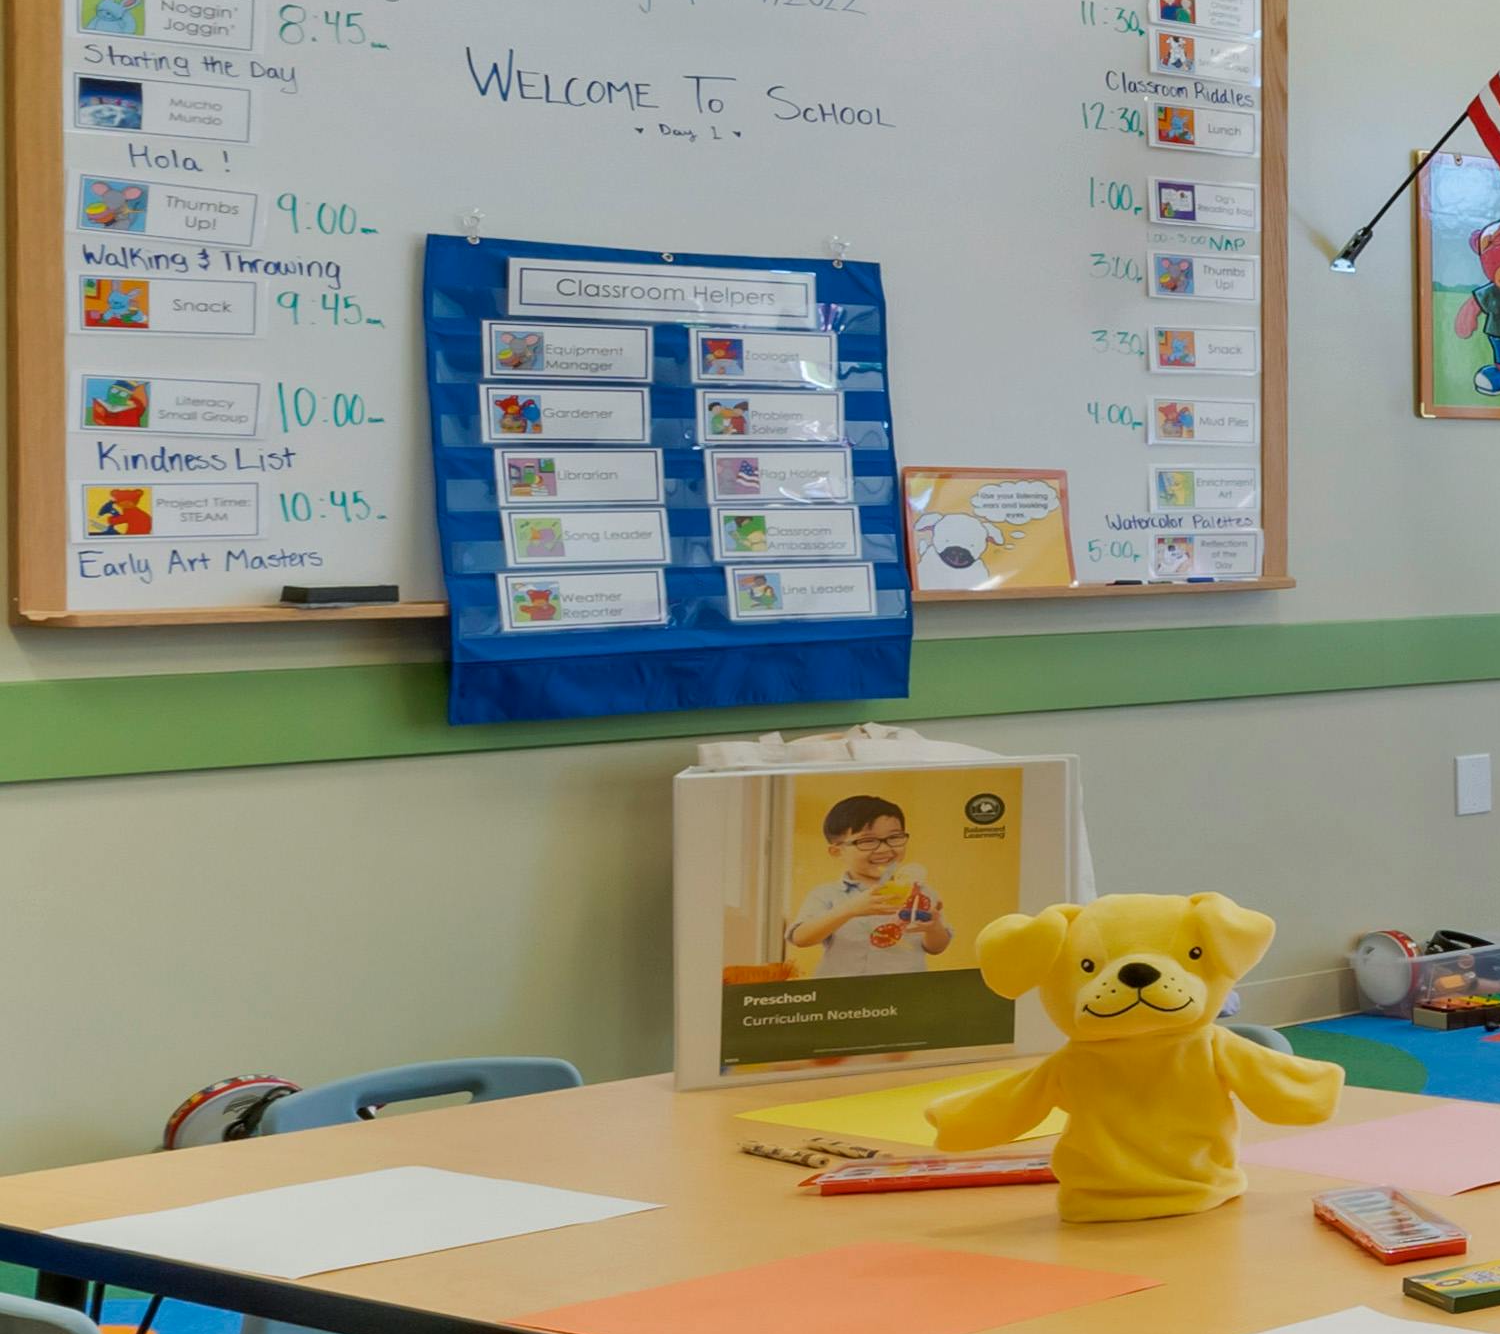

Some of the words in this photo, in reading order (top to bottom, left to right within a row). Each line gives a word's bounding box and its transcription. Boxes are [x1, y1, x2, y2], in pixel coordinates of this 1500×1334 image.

[85, 44, 191, 77] Starting
[200, 56, 240, 78] the
[250, 61, 298, 94] Day
[466, 47, 659, 109] WELCOME
[1105, 70, 1188, 98] Classroom
[1194, 82, 1254, 107] Riddles
[169, 98, 223, 112] Mucho
[169, 112, 223, 126] Mundo
[660, 123, 696, 142] Day
[1207, 123, 1241, 136] Lunch
[128, 143, 203, 172] Hola
[166, 195, 240, 216] Thumbs
[184, 215, 216, 232] Up!
[1209, 235, 1245, 251] NAP
[82, 244, 188, 273] Walking
[220, 251, 341, 290] Throwing
[1203, 265, 1245, 278] Thumbs
[1216, 279, 1233, 291] Up!
[555, 278, 686, 302] Classroom
[693, 285, 775, 310] Helpers
[172, 298, 232, 314] Snack
[545, 344, 623, 357] Equipment
[1208, 343, 1242, 355] Snack
[745, 350, 799, 363] Zoologist
[545, 360, 613, 372] Manager
[176, 396, 235, 410] Literacy
[158, 410, 197, 422] Small
[201, 411, 248, 425] Group
[543, 408, 613, 419] Gardener
[751, 410, 804, 420] Problem
[1200, 417, 1225, 427] Mud
[1229, 418, 1249, 427] Pies
[752, 426, 788, 434] Solver
[97, 441, 227, 472] Kindness
[235, 447, 296, 471] List
[558, 470, 618, 481] Librarian
[761, 469, 786, 480] Flag
[789, 468, 830, 478] Holder
[1196, 478, 1253, 487] Enrichment
[1218, 490, 1232, 499] Art
[156, 496, 208, 510] Project
[212, 496, 252, 508] Time:
[180, 511, 228, 523] STEAM
[1192, 514, 1253, 529] Palettes
[564, 530, 599, 543] Song
[604, 529, 653, 540] Leader
[767, 526, 832, 537] Classroom
[768, 541, 847, 551] Ambassador
[1201, 539, 1248, 548] Reflections
[78, 550, 153, 583] Early
[168, 549, 210, 574] Art
[226, 549, 323, 571] Masters
[782, 586, 807, 595] Line
[811, 584, 855, 595] Leader
[562, 591, 622, 604] Weather
[563, 606, 624, 619] Reporter
[743, 991, 816, 1007] Preschool
[742, 1011, 824, 1027] Curriculum
[827, 1006, 898, 1020] Notebook
